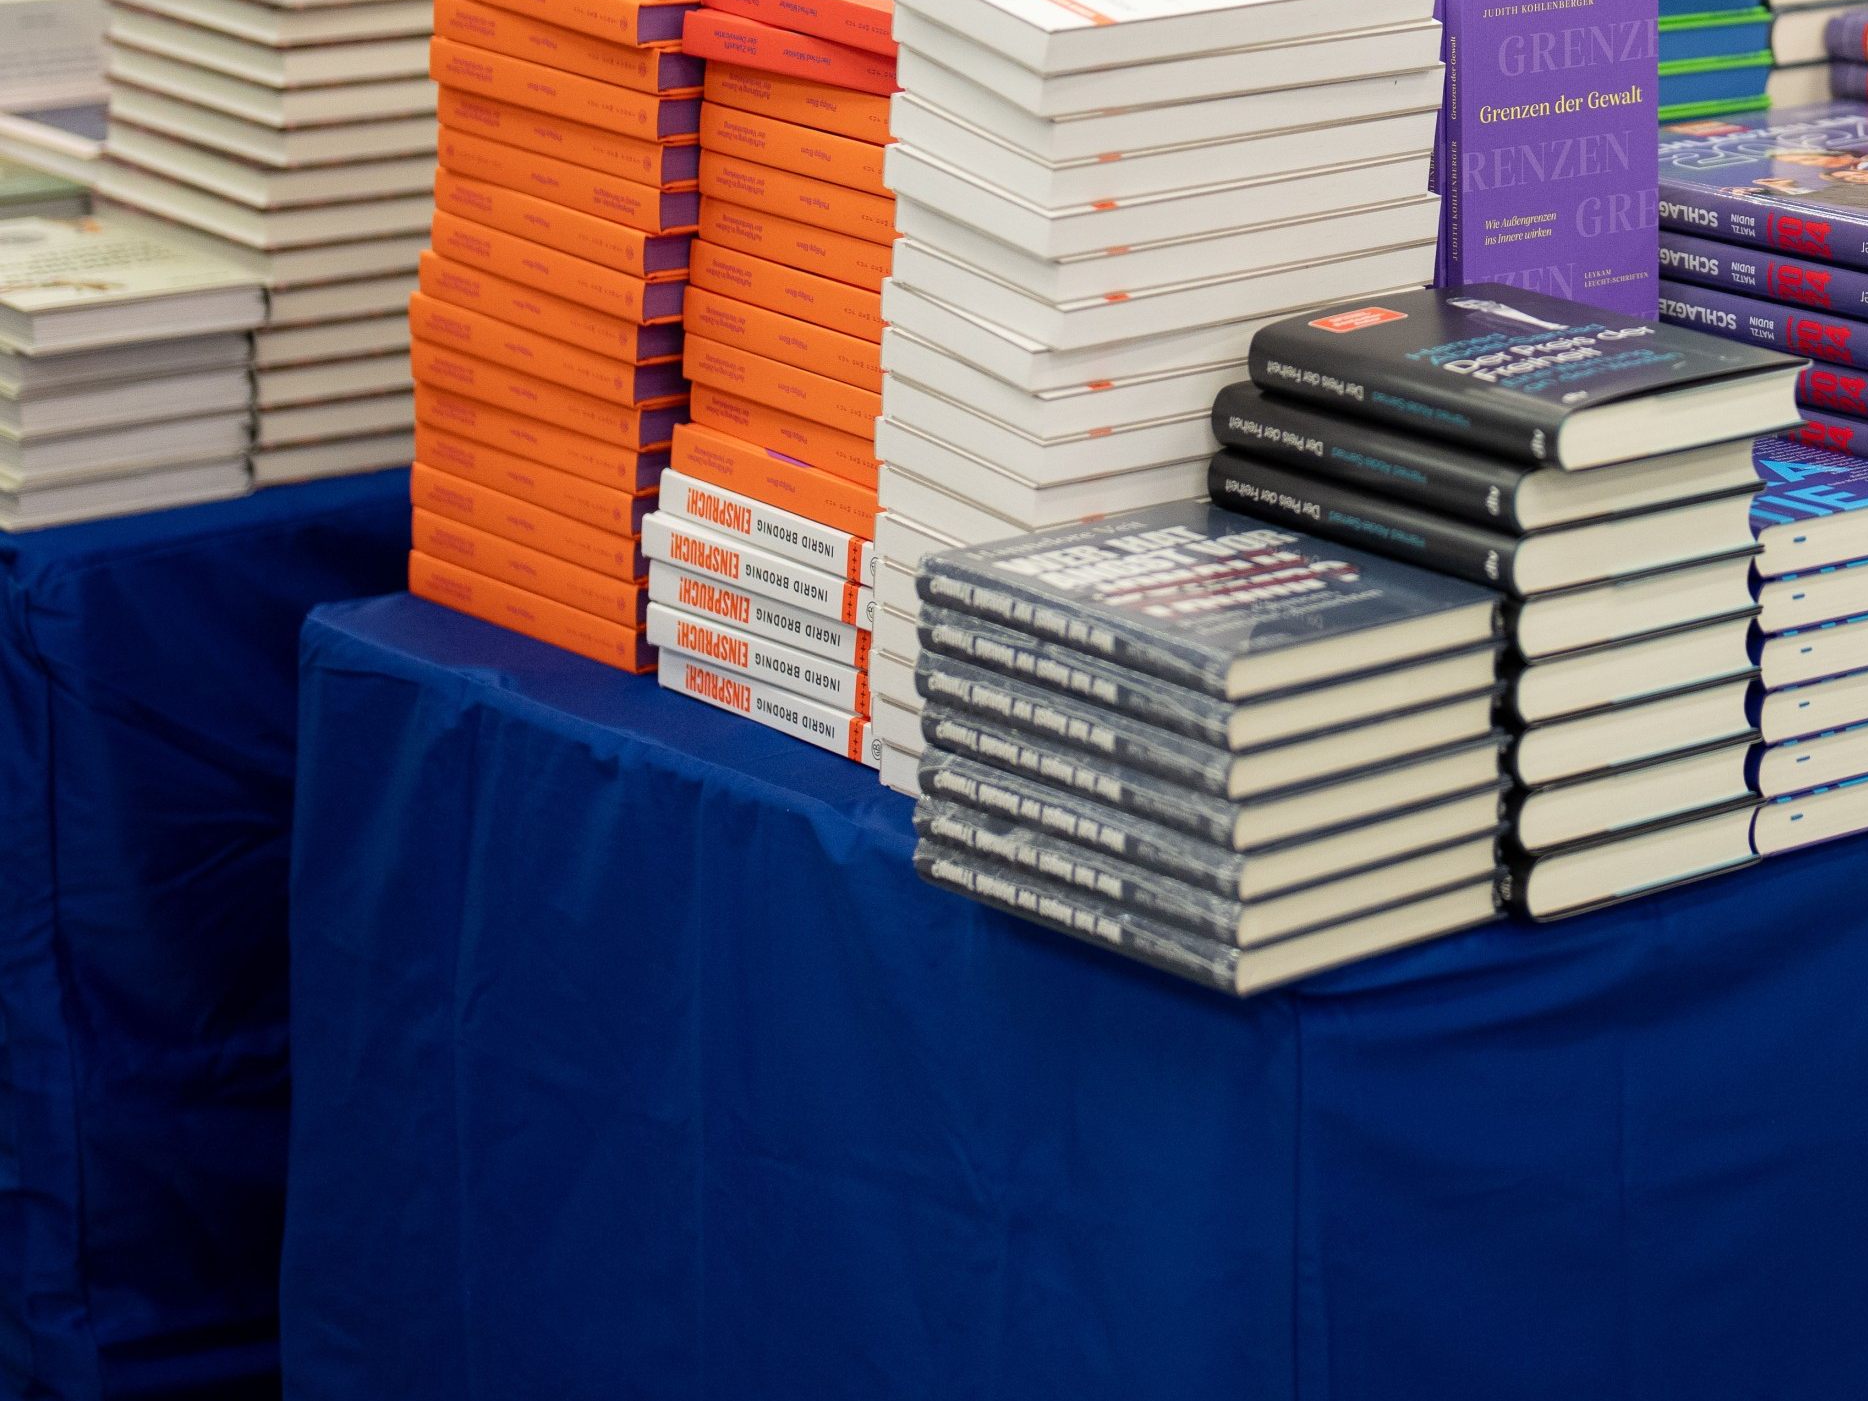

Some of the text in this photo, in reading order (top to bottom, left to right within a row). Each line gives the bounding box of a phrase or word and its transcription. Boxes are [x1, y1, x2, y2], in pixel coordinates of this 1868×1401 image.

[1482, 5, 1519, 19] JUDITH
[1479, 84, 1644, 125] Grenzen der Gewalt
[1484, 211, 1558, 231] Wie Außengrenzen
[1484, 227, 1553, 247] ins Innere wirken
[1730, 214, 1756, 227] BUDIN
[1731, 224, 1756, 237] MATZL
[1583, 268, 1613, 281] LEYKAM
[1730, 261, 1756, 275] BUDIN
[1731, 272, 1756, 286] MATZL
[1748, 316, 1774, 330] BUDIN
[1749, 326, 1775, 341] MATZL
[1444, 351, 1512, 374] Der
[1510, 335, 1597, 357] Preis
[1596, 325, 1656, 341] der
[1473, 347, 1603, 382] Freiheit
[1266, 360, 1365, 401] Der Preis der Freiheit
[1228, 415, 1324, 457] Der Preis der Freiheit
[1224, 478, 1321, 520] Der Preis der Freiheit
[686, 487, 834, 558] INGRID BRODNIG EINSPRUCH!
[670, 533, 828, 602] INGRID BRODNIG EINSPRUCH!
[992, 525, 1211, 577] WER HAT
[679, 577, 841, 646] INGRID BRODNIG EINSPRUCH!
[676, 620, 840, 692] INGRID BRODNIG EINSPRUCH!
[684, 663, 835, 739] INGRID BRODNIG EINSPRUCH!
